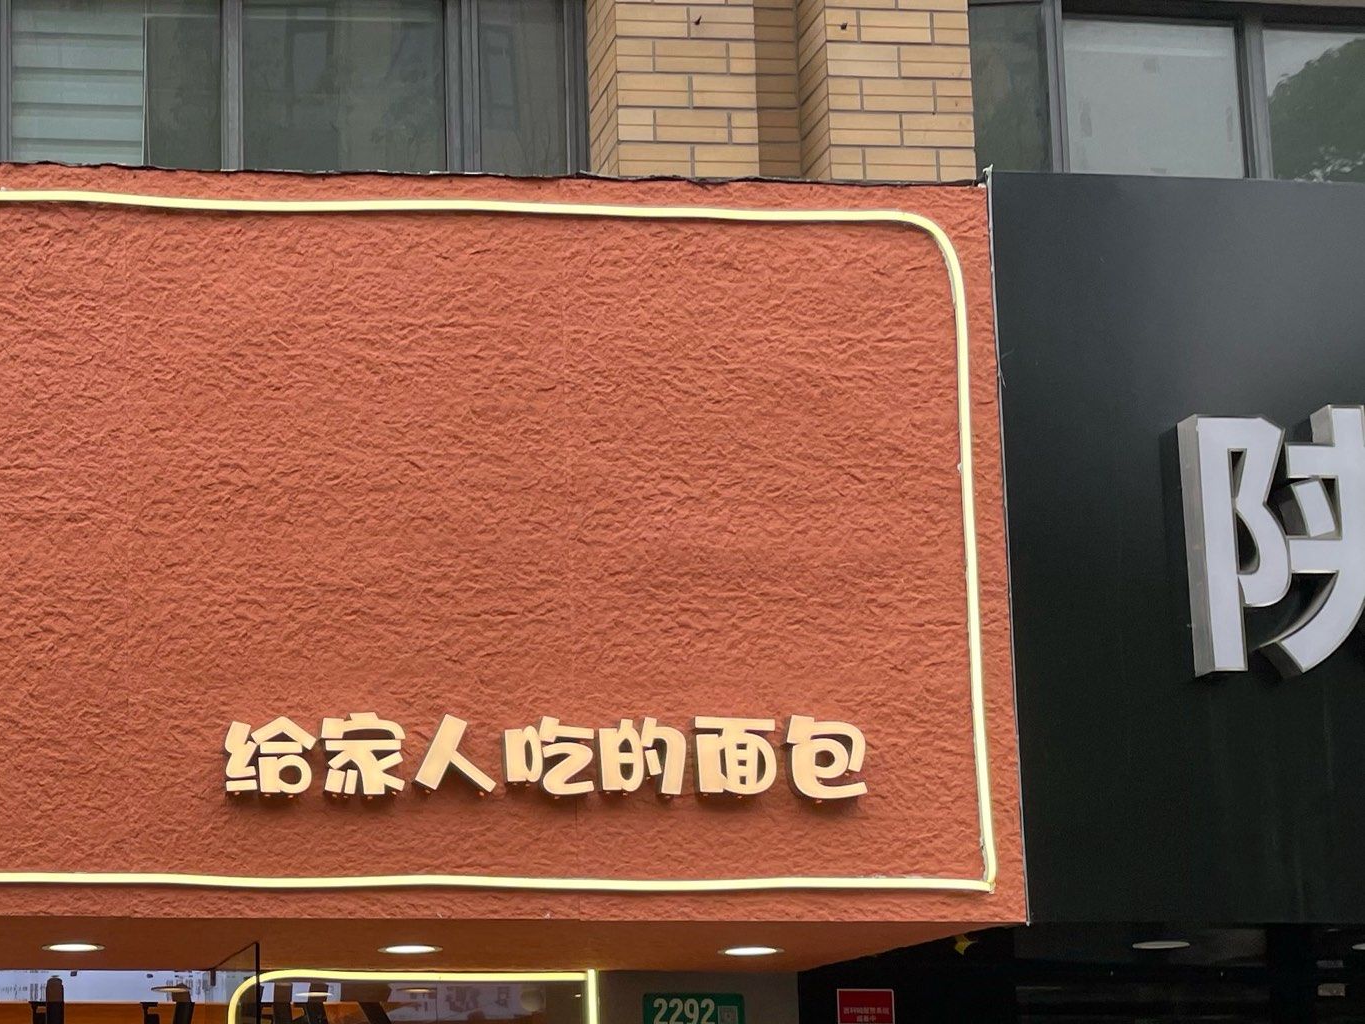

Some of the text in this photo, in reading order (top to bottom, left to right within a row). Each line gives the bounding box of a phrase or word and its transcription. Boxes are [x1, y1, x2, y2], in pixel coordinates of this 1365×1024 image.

[224, 711, 868, 800] 给家人吃的面包
